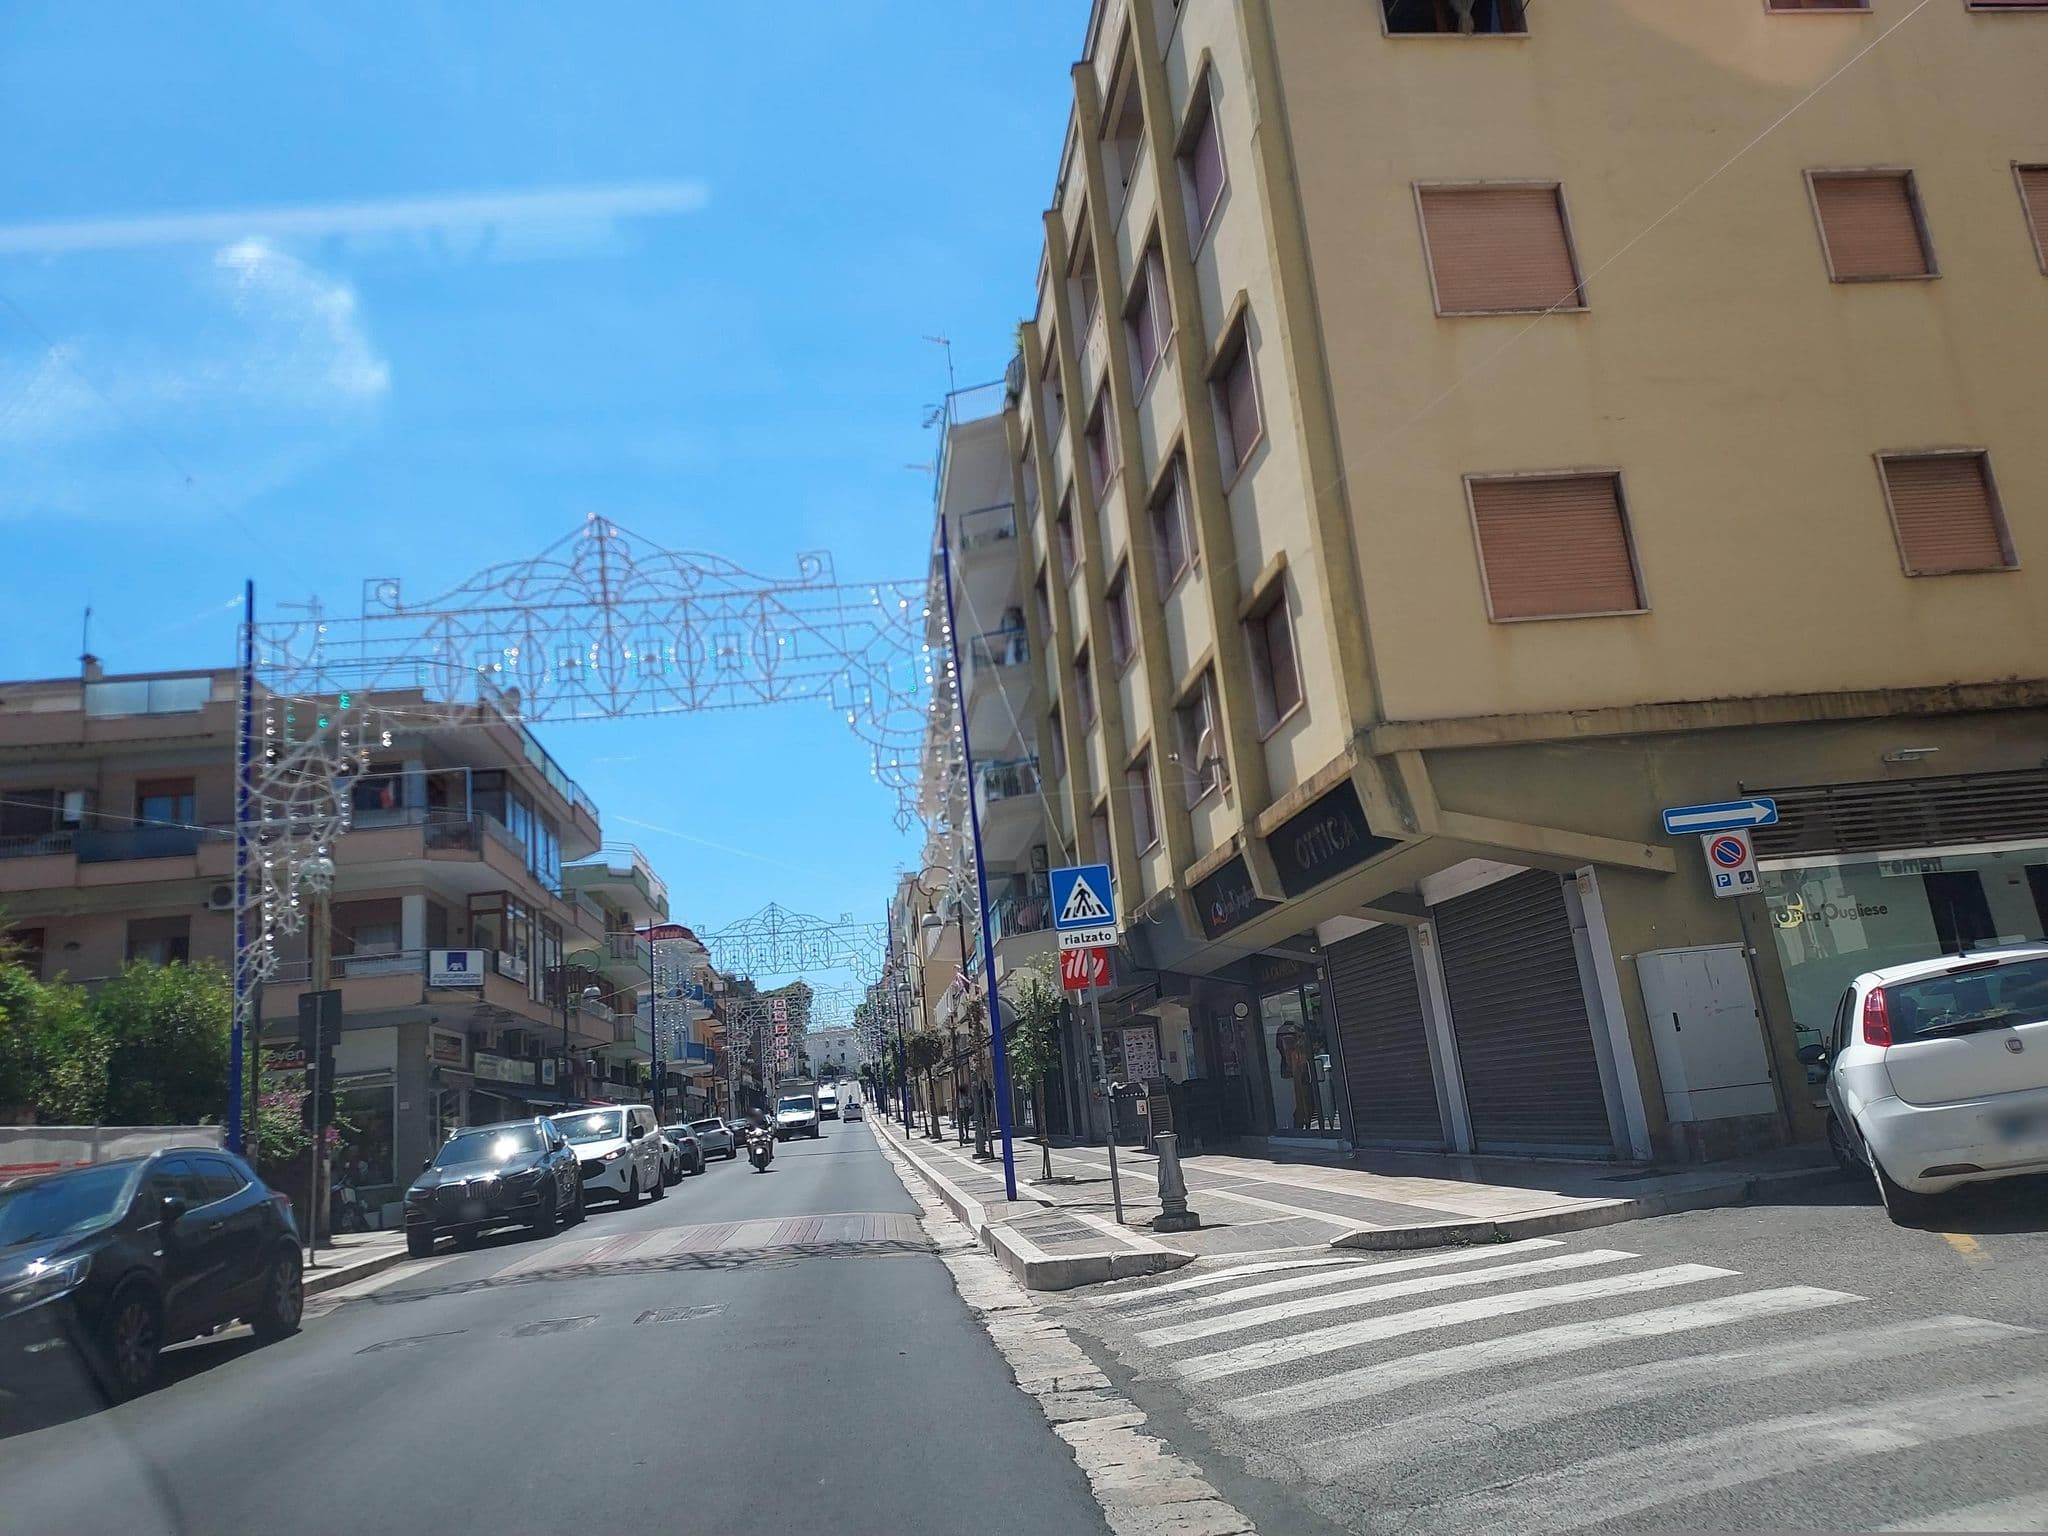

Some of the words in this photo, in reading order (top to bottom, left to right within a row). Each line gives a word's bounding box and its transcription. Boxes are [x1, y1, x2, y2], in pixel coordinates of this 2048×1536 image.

[1294, 812, 1360, 869] OTTICA
[1718, 875, 1729, 887] P
[1064, 931, 1112, 945] rialzato
